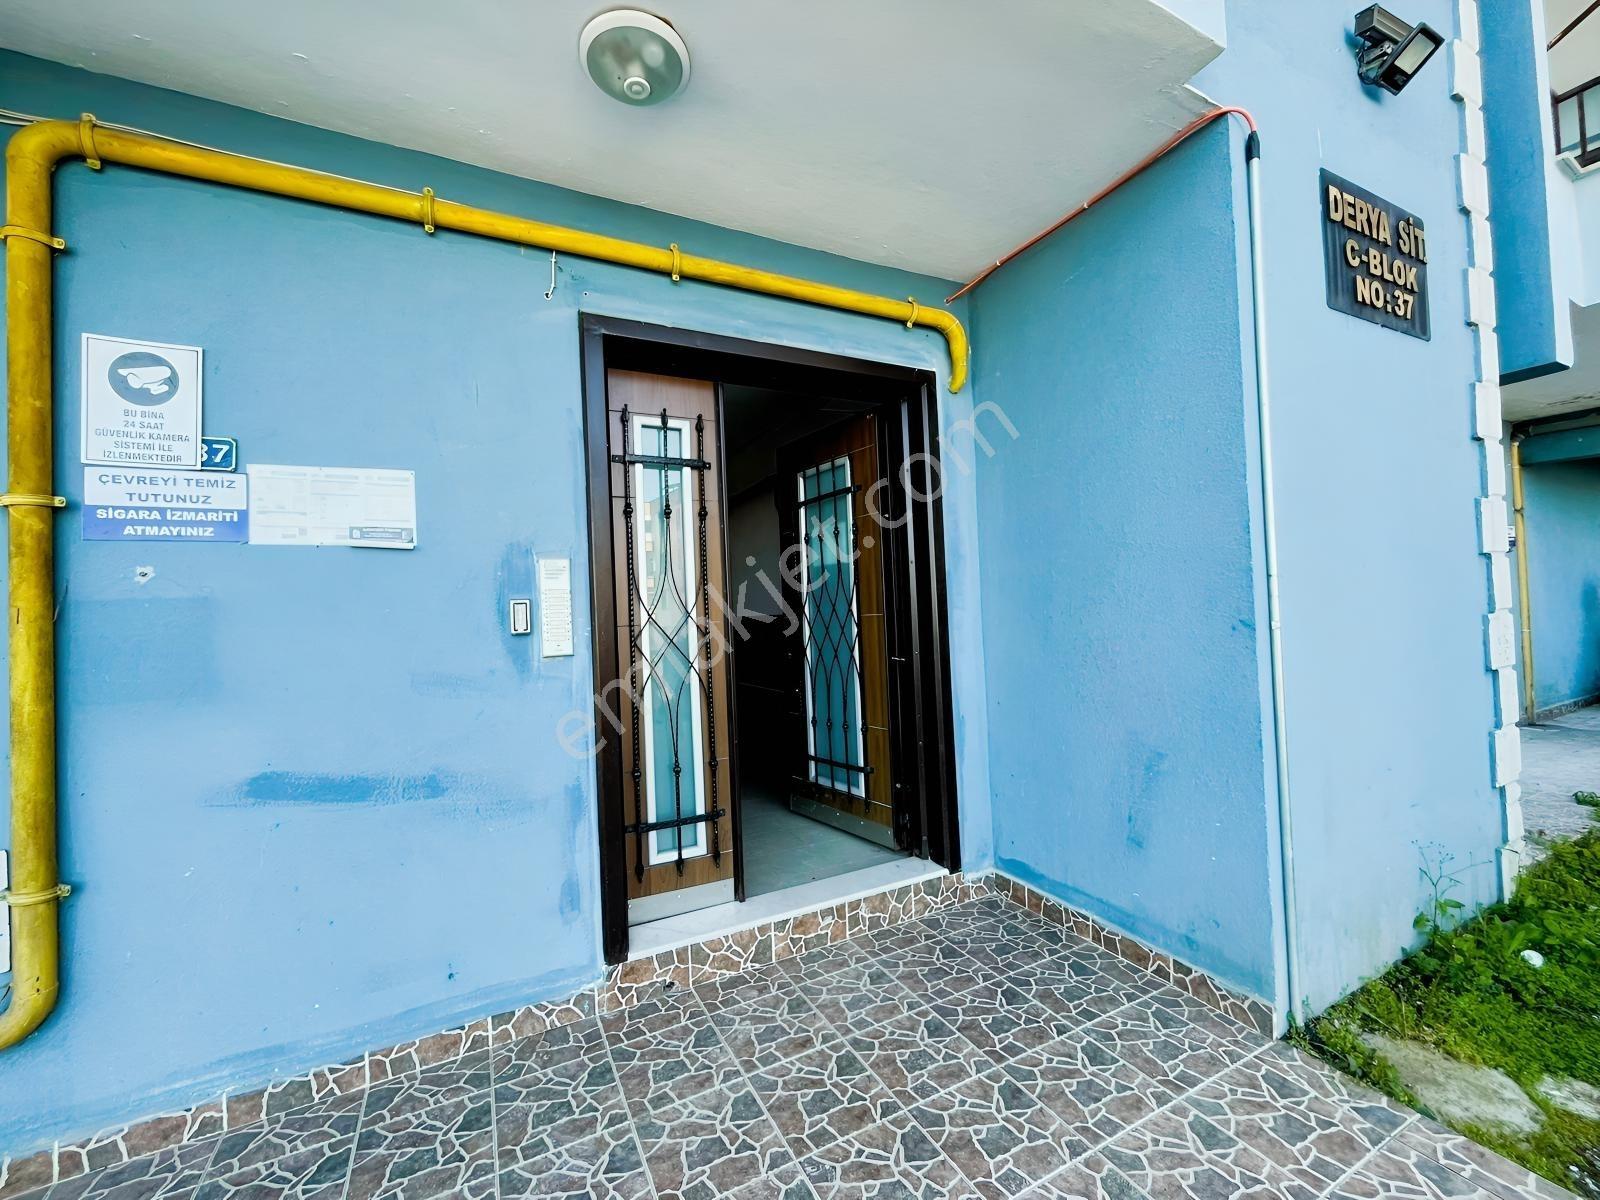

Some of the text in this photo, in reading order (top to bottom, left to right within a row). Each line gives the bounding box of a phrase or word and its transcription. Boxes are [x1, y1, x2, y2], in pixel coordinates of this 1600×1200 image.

[1328, 184, 1392, 247] DERYA
[1345, 238, 1418, 293] C-BLOK
[1356, 274, 1414, 320] NO:37
[123, 408, 165, 420] BU BİNA
[123, 420, 165, 431] 24 SAAT
[149, 432, 190, 442] KAMERA
[113, 440, 155, 451] SİSTEMİ
[98, 473, 236, 489] ÇEVREYİ TEMİZ
[125, 492, 212, 505] TUTUNUZ
[96, 507, 239, 523] SİGARA İZMARİTİ
[123, 525, 215, 538] ATMAYINIZ
